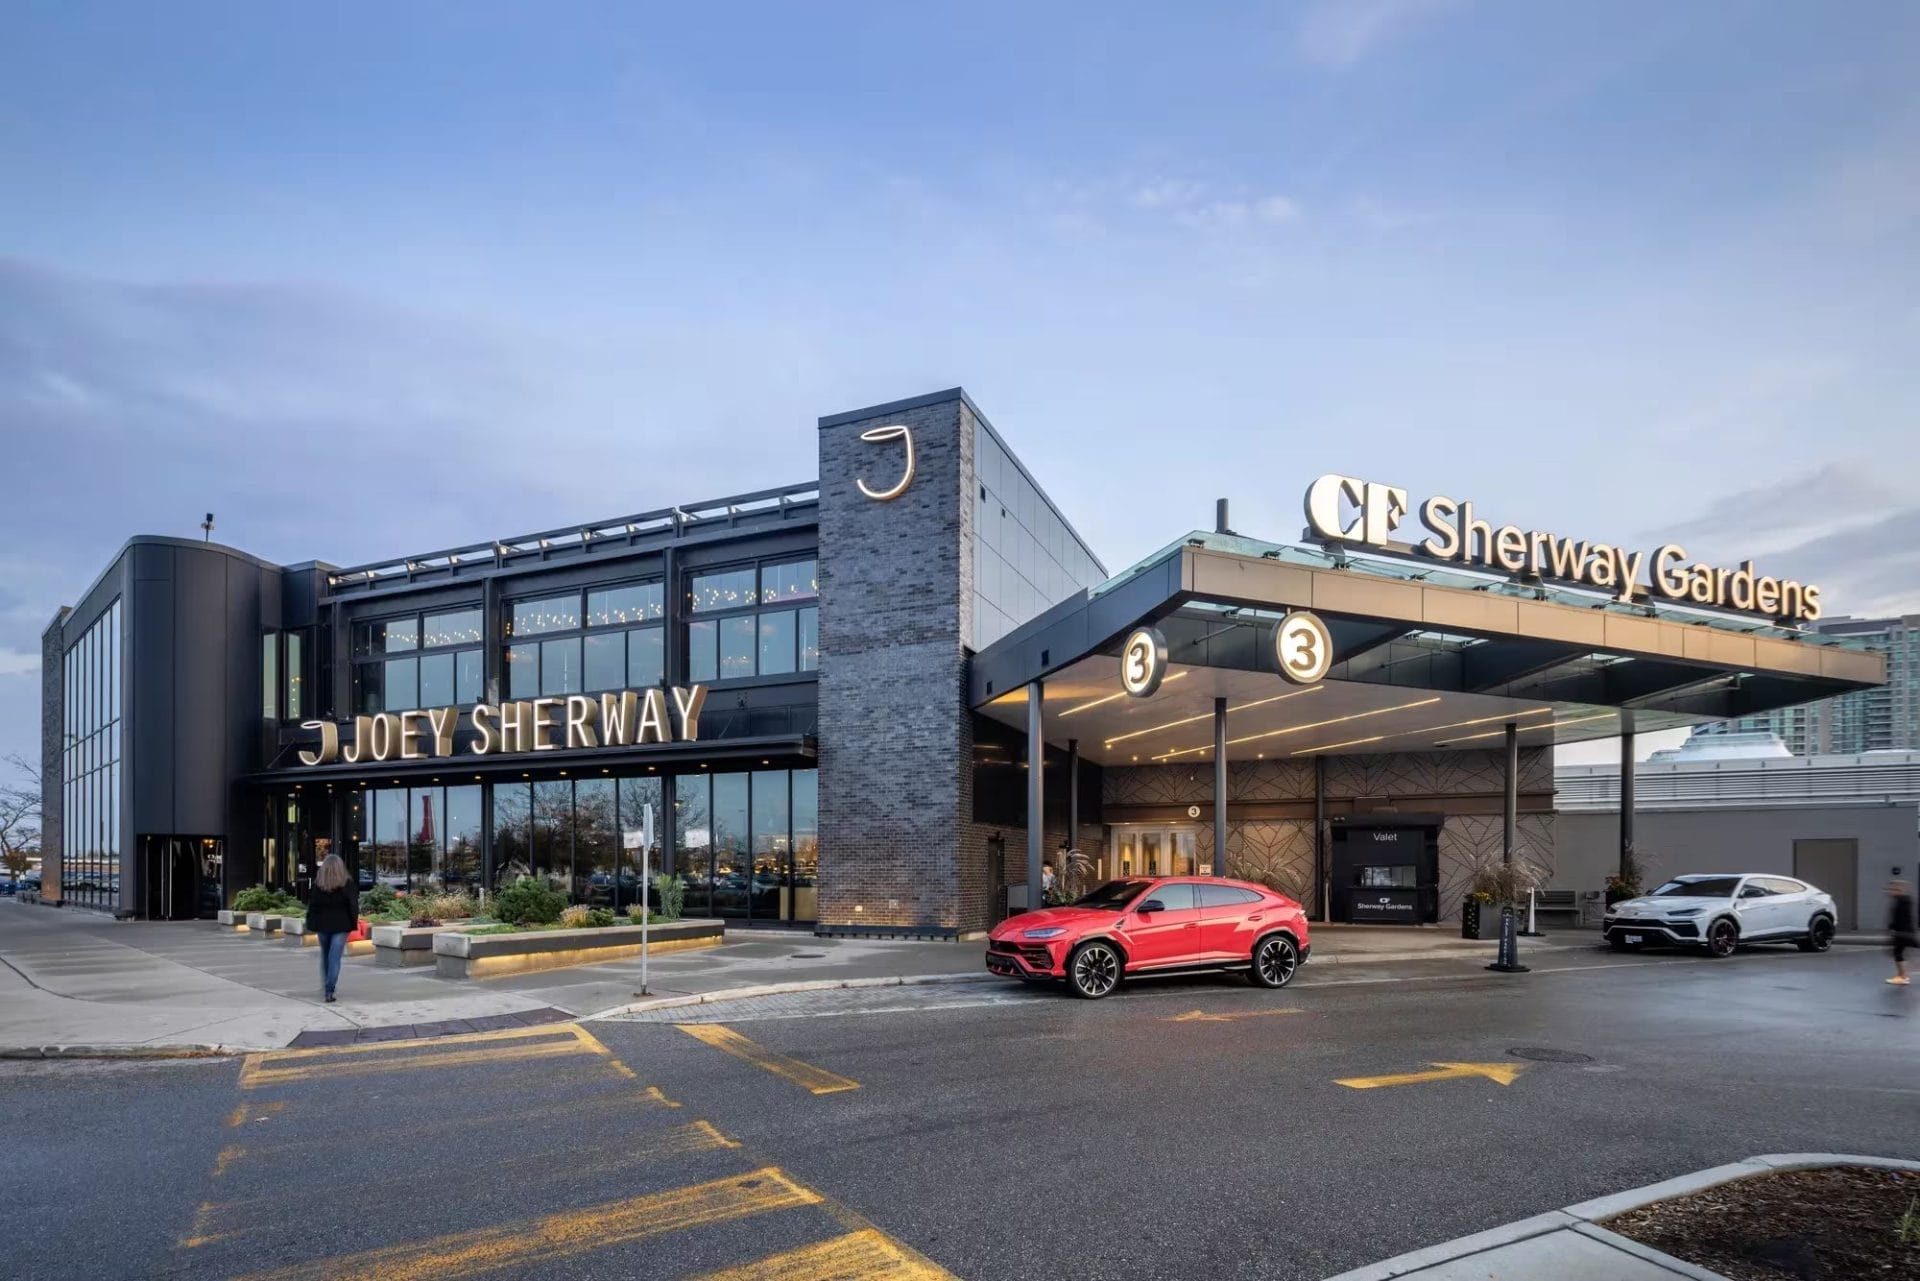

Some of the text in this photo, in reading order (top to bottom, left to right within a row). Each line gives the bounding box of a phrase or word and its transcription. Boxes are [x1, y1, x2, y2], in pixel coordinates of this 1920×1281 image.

[1303, 473, 1822, 621] CF Sherway Gardens
[1129, 642, 1150, 684] 3
[1289, 628, 1317, 671] 3
[344, 708, 460, 763] JOEY
[471, 685, 709, 755] SHERWAY
[1373, 833, 1398, 841] Valet
[1357, 902, 1384, 910] Sherway
